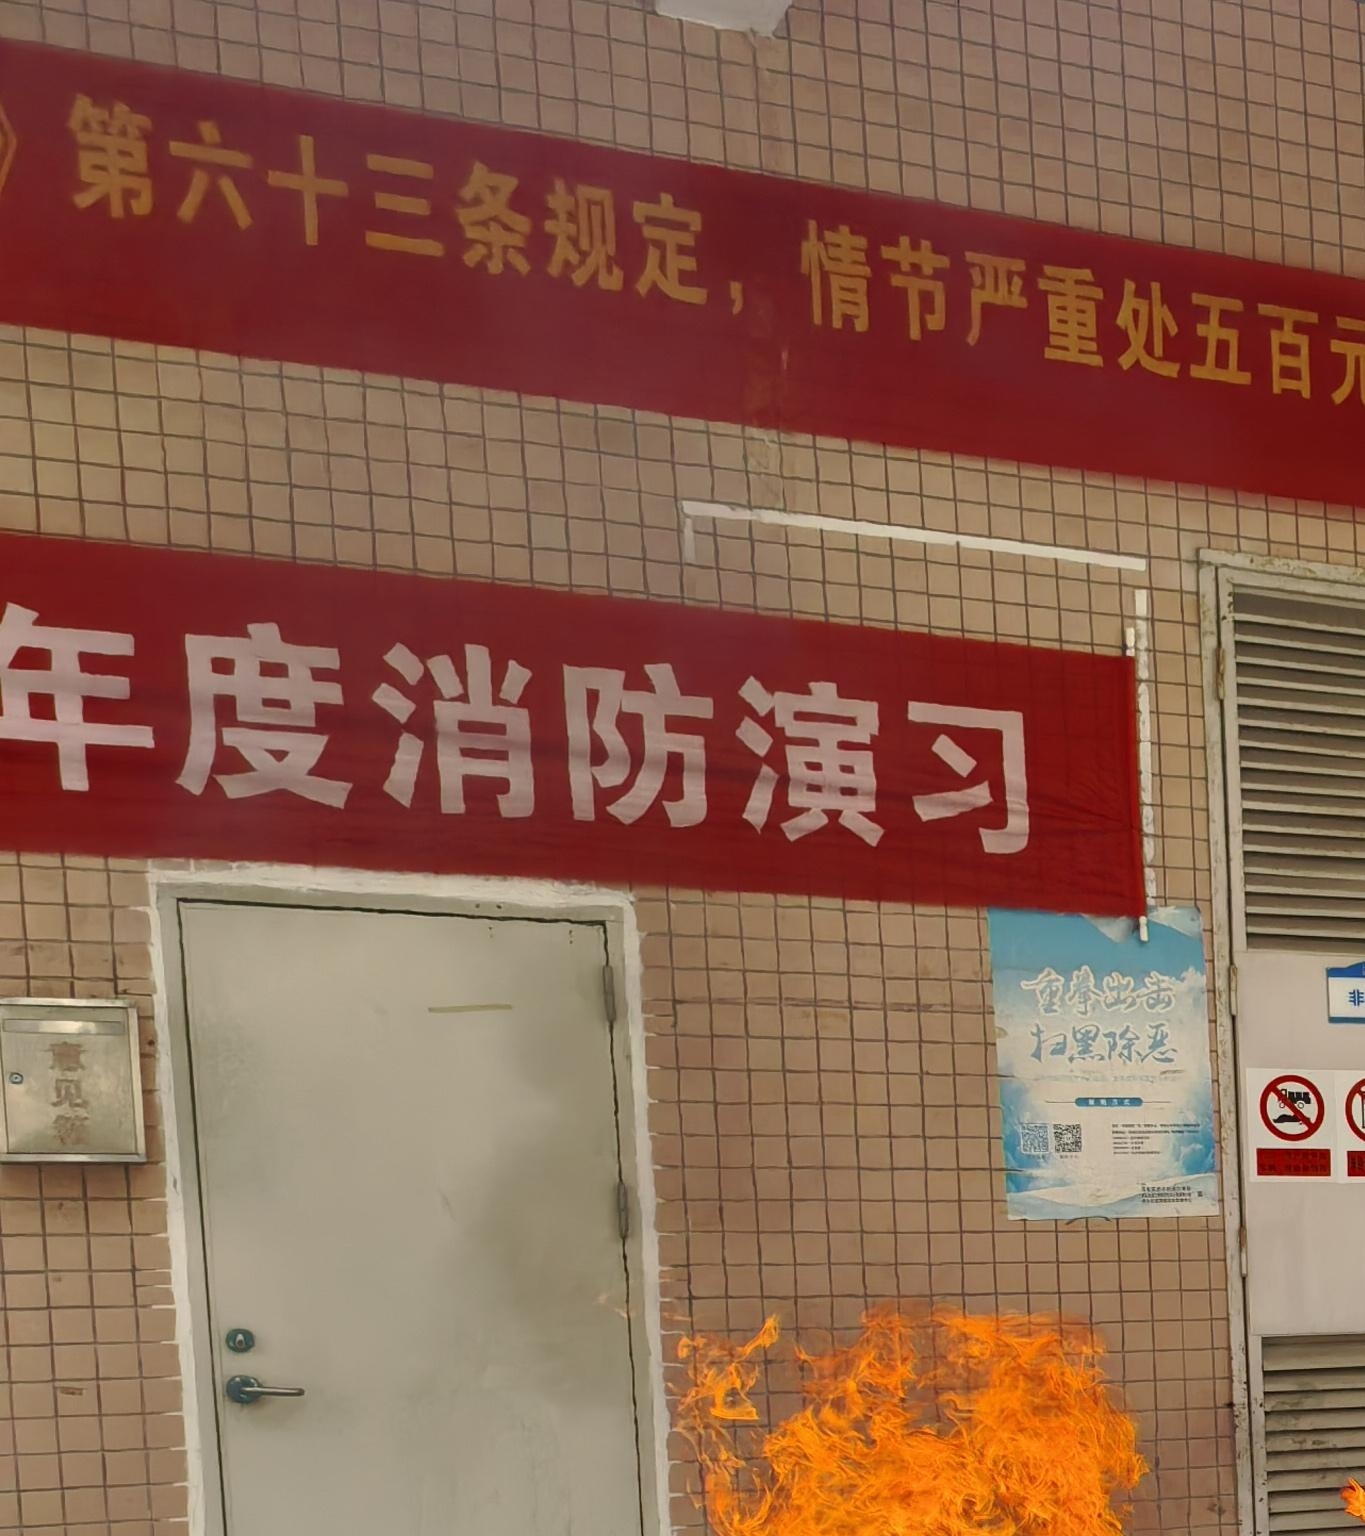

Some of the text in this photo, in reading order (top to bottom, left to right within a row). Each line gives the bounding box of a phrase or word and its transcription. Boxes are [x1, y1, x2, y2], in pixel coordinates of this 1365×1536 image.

[0, 604, 1032, 856] 年度消防演习
[1020, 965, 1176, 1016] 重拳出击
[1030, 1022, 1178, 1064] 扫黑除恶
